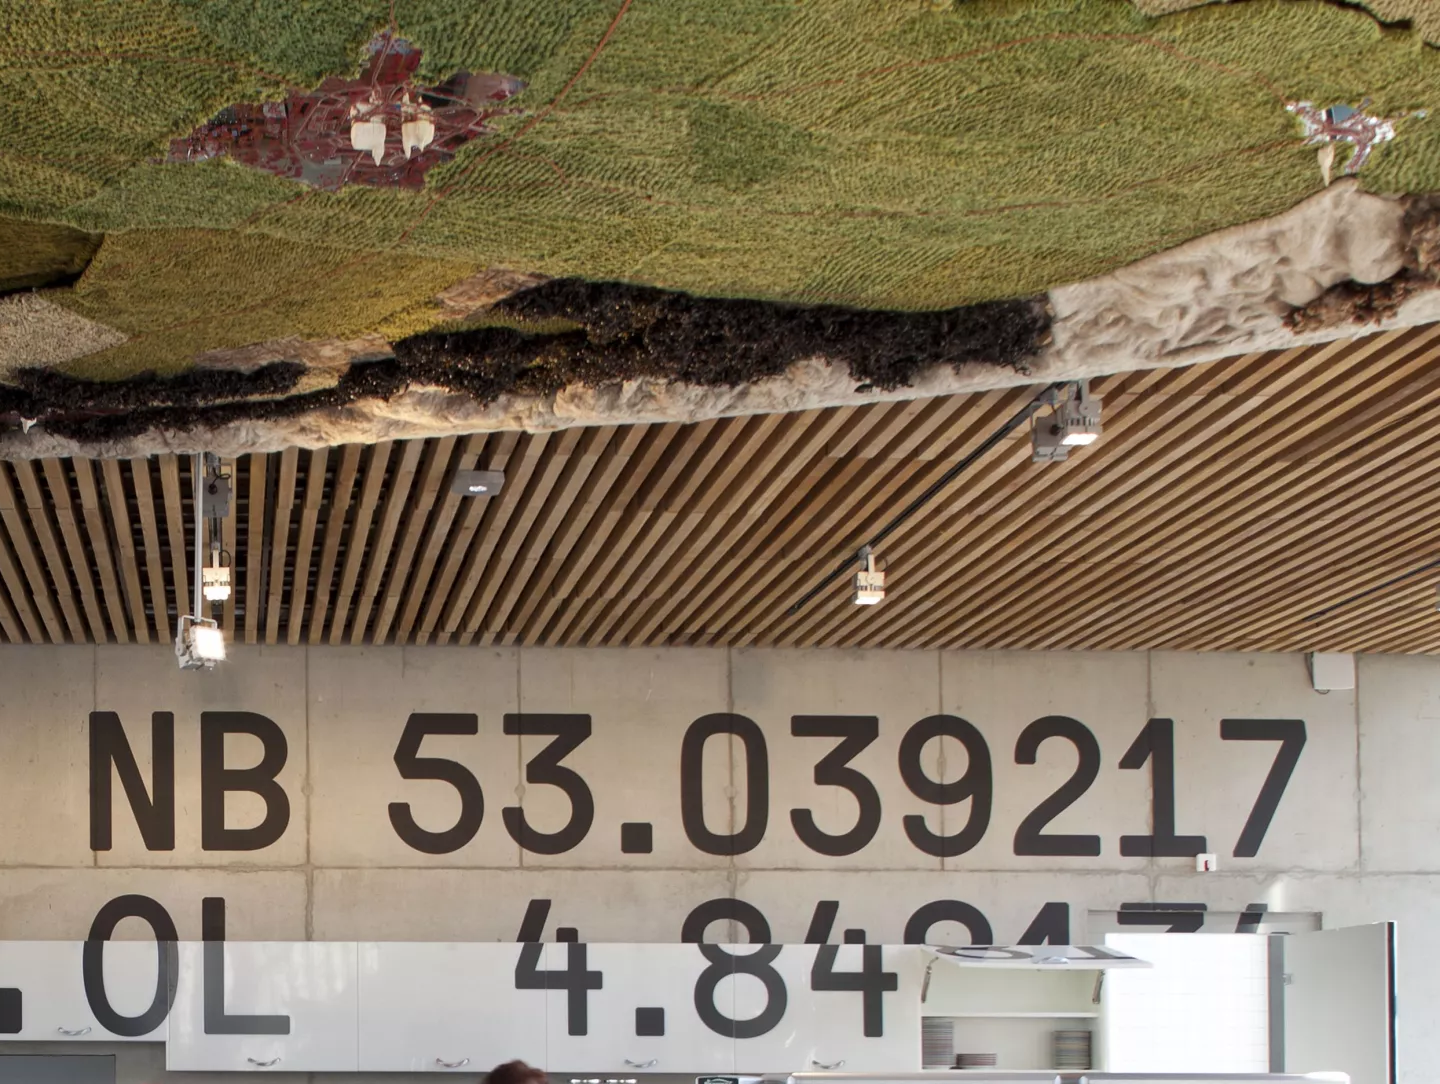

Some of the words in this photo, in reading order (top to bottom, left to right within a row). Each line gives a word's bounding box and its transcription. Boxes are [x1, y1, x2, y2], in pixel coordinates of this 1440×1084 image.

[89, 711, 291, 852] NB
[388, 711, 1307, 858] 53.039217
[83, 894, 291, 1037] OL
